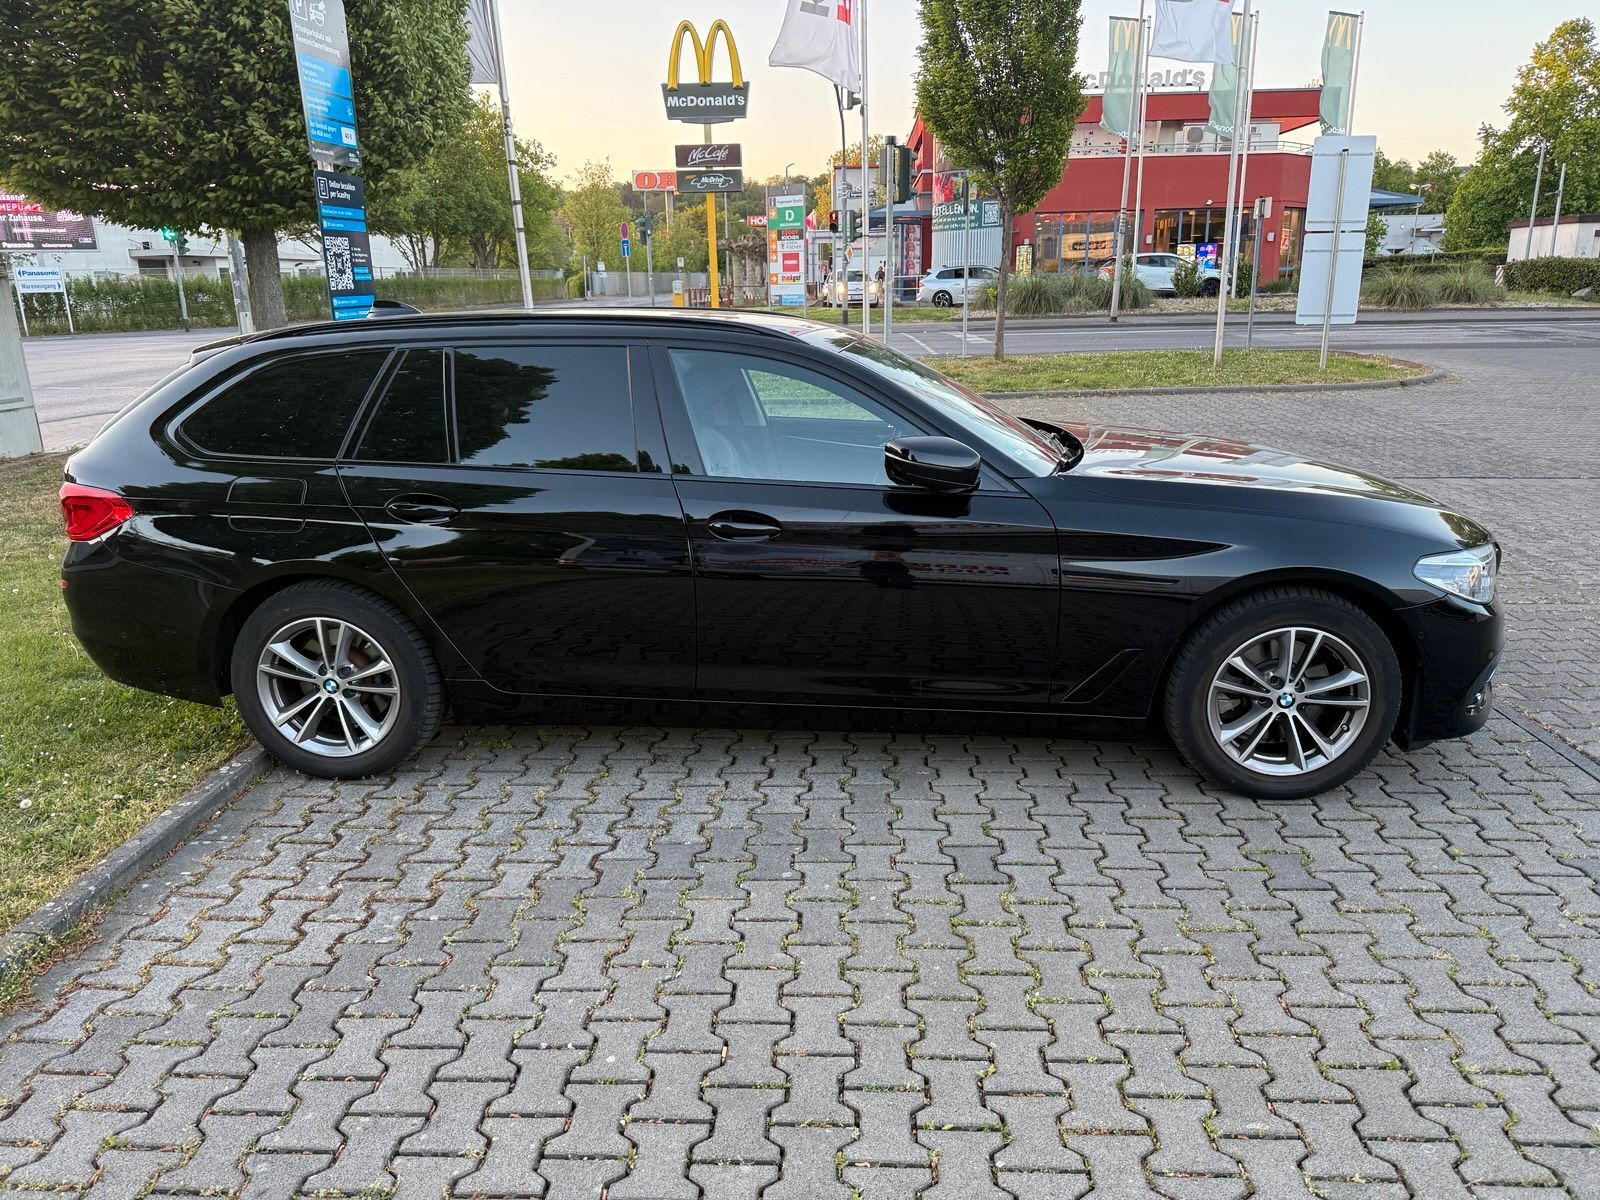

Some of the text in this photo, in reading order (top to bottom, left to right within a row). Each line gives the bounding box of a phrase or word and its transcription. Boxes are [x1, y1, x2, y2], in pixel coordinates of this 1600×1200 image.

[667, 95, 745, 107] McDonald's
[688, 145, 729, 164] McCafé
[700, 176, 725, 184] McDrive
